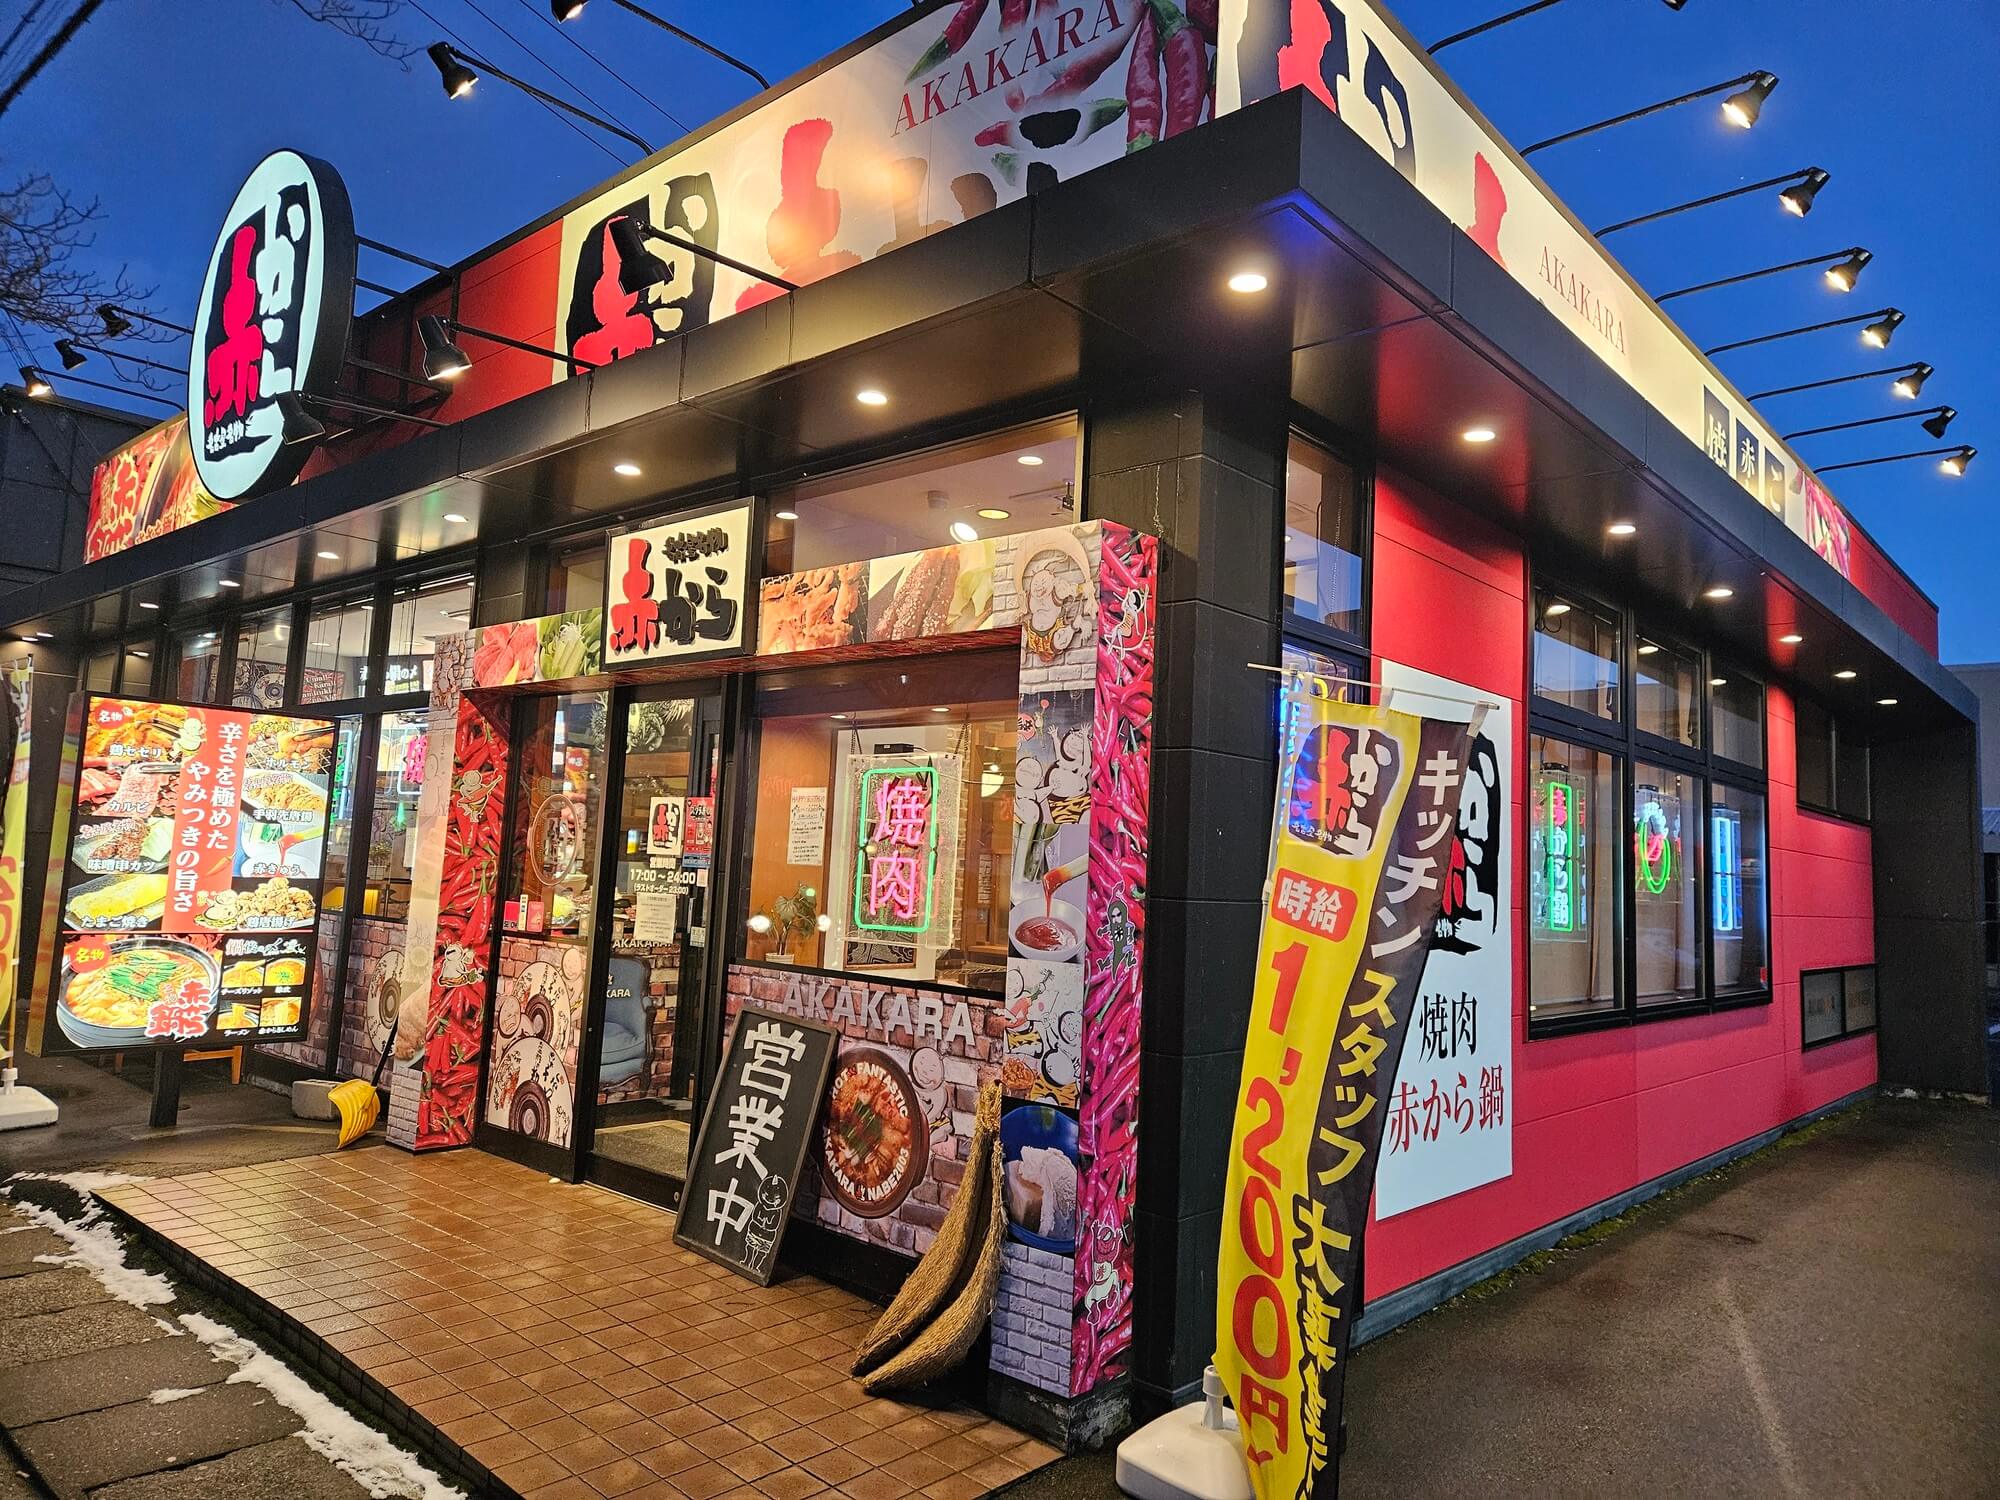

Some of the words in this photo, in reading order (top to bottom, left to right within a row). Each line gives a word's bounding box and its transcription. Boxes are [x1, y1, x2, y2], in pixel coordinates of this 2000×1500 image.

[891, 0, 1124, 137] AKAKARA
[1538, 245, 1627, 355] AKAKARA
[610, 537, 737, 656] 赤から
[107, 801, 149, 813] カルビ
[206, 722, 242, 850] 辛さを極めた
[173, 761, 210, 912] やみつきの旨さ
[869, 777, 929, 919] 焼肉
[81, 915, 149, 928] たまご焼き
[1277, 876, 1343, 934] 時給
[782, 977, 976, 1047] AKAKARA
[1418, 991, 1478, 1063] 焼肉
[705, 1019, 807, 1247] 営業中
[855, 1061, 908, 1119] FANTASTIC
[1388, 1063, 1505, 1157] 赤から鍋
[867, 1147, 909, 1201] NABE2003
